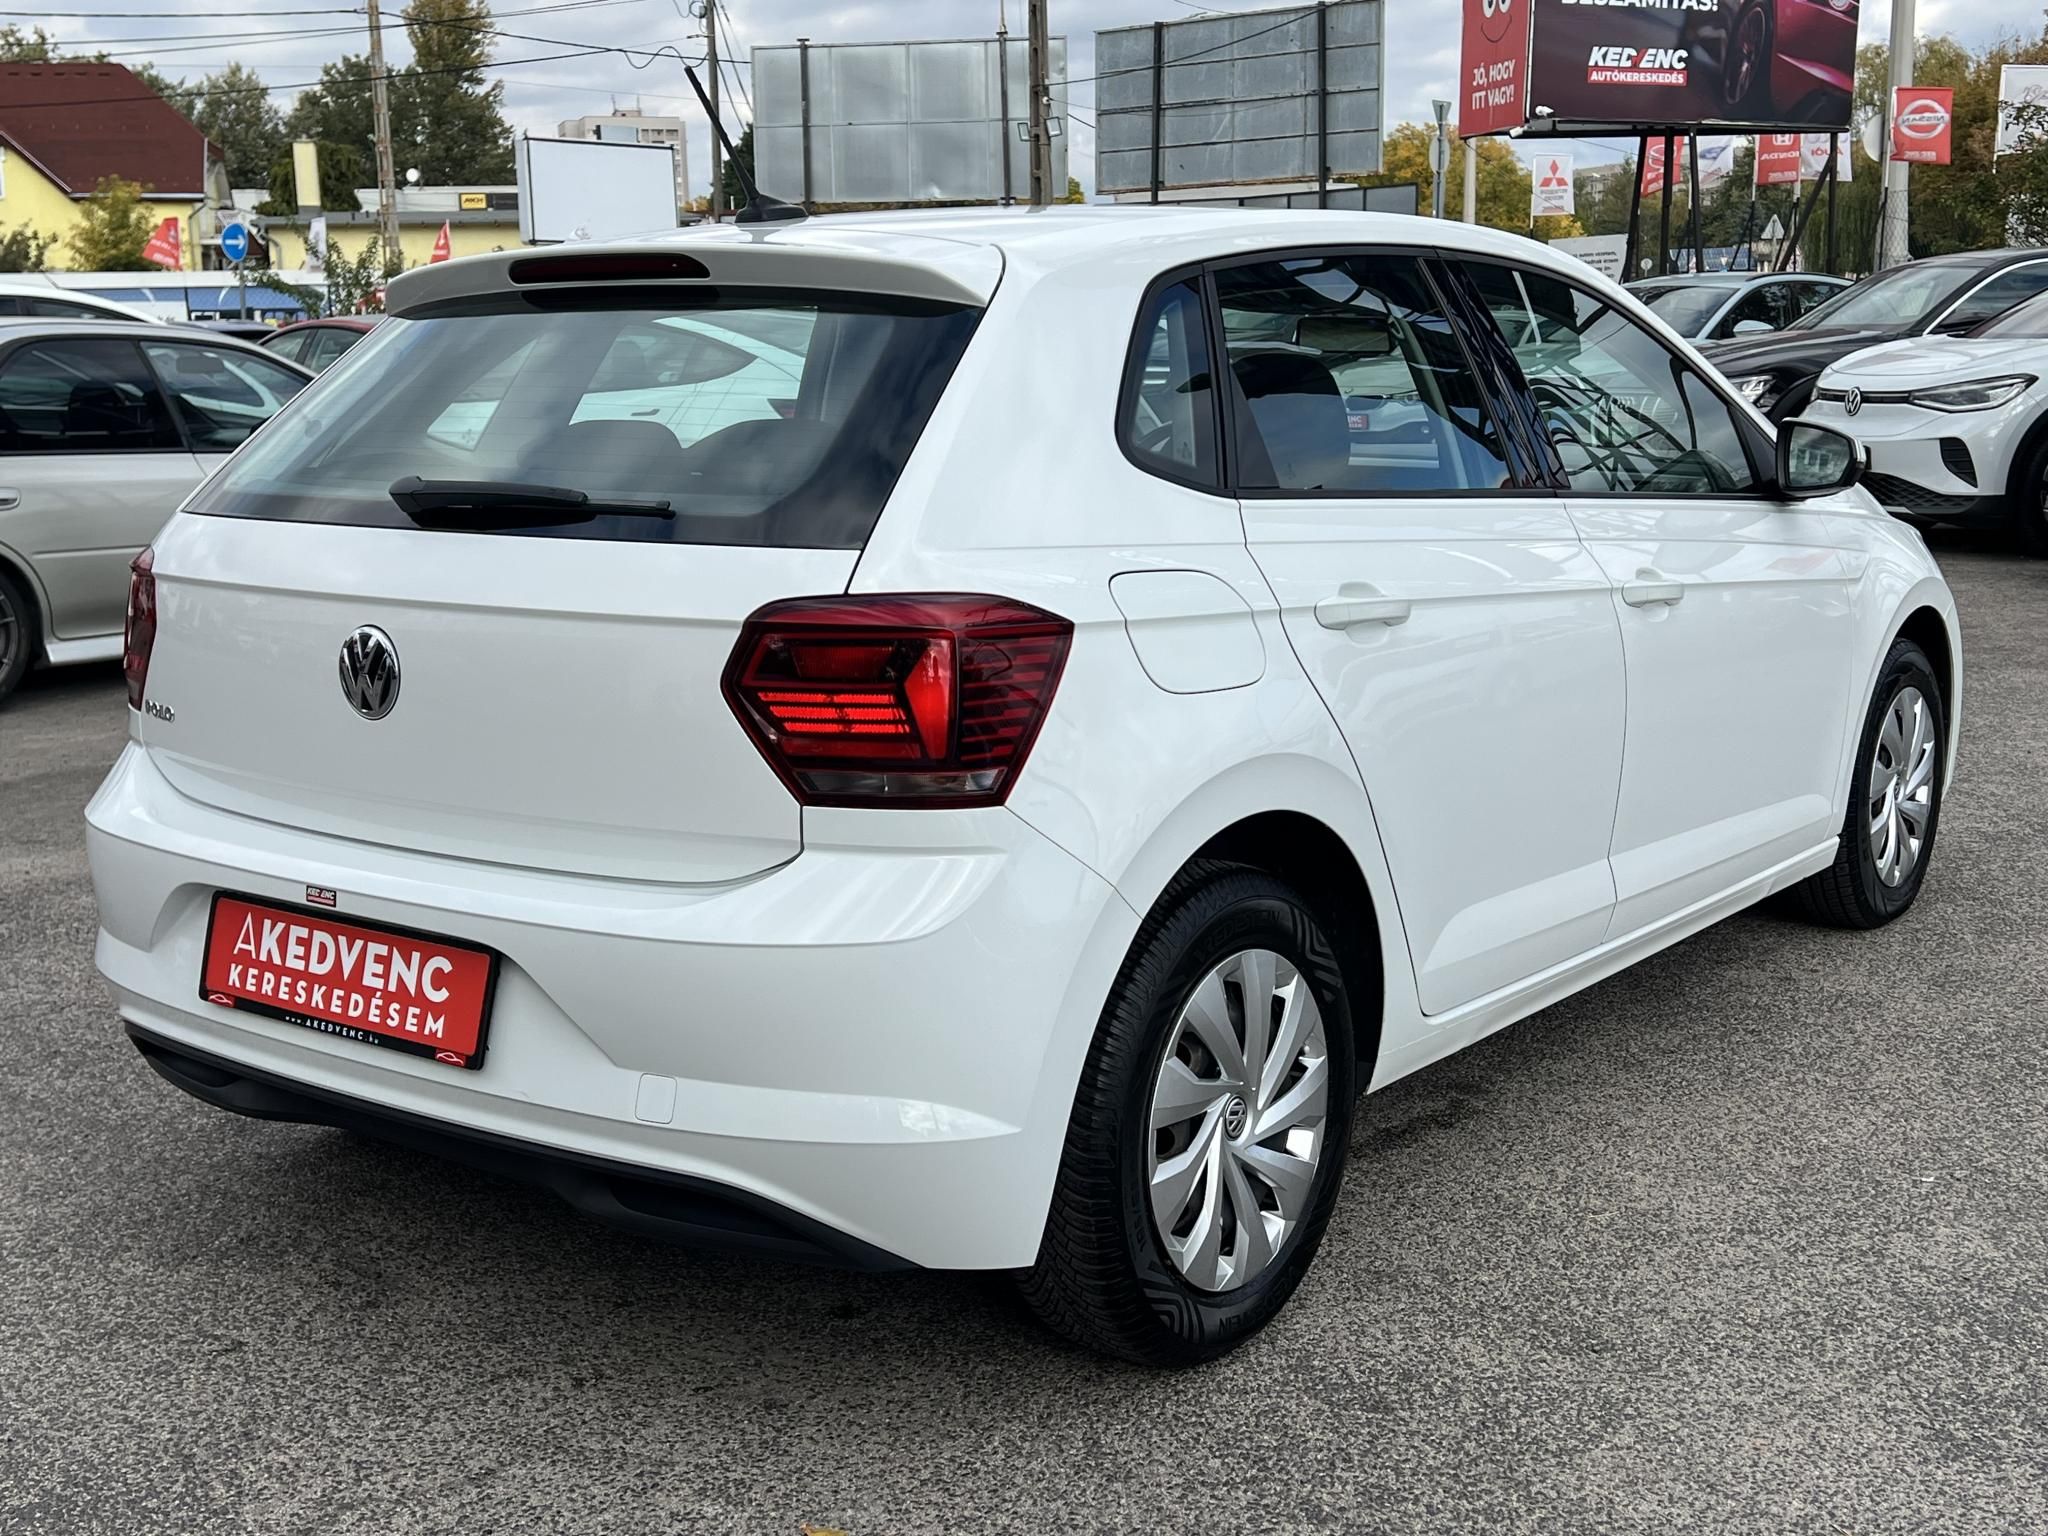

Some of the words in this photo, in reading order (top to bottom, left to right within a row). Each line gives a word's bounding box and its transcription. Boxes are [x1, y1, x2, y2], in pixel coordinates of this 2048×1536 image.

[1472, 62, 1487, 87] JÓ,
[1489, 59, 1516, 83] HOGY
[1590, 70, 1685, 84] AUTÓKERESKEDÉS
[1471, 90, 1487, 110] ITT
[1487, 84, 1515, 107] VAGY!
[228, 962, 446, 1040] KERESKEDÉSEM
